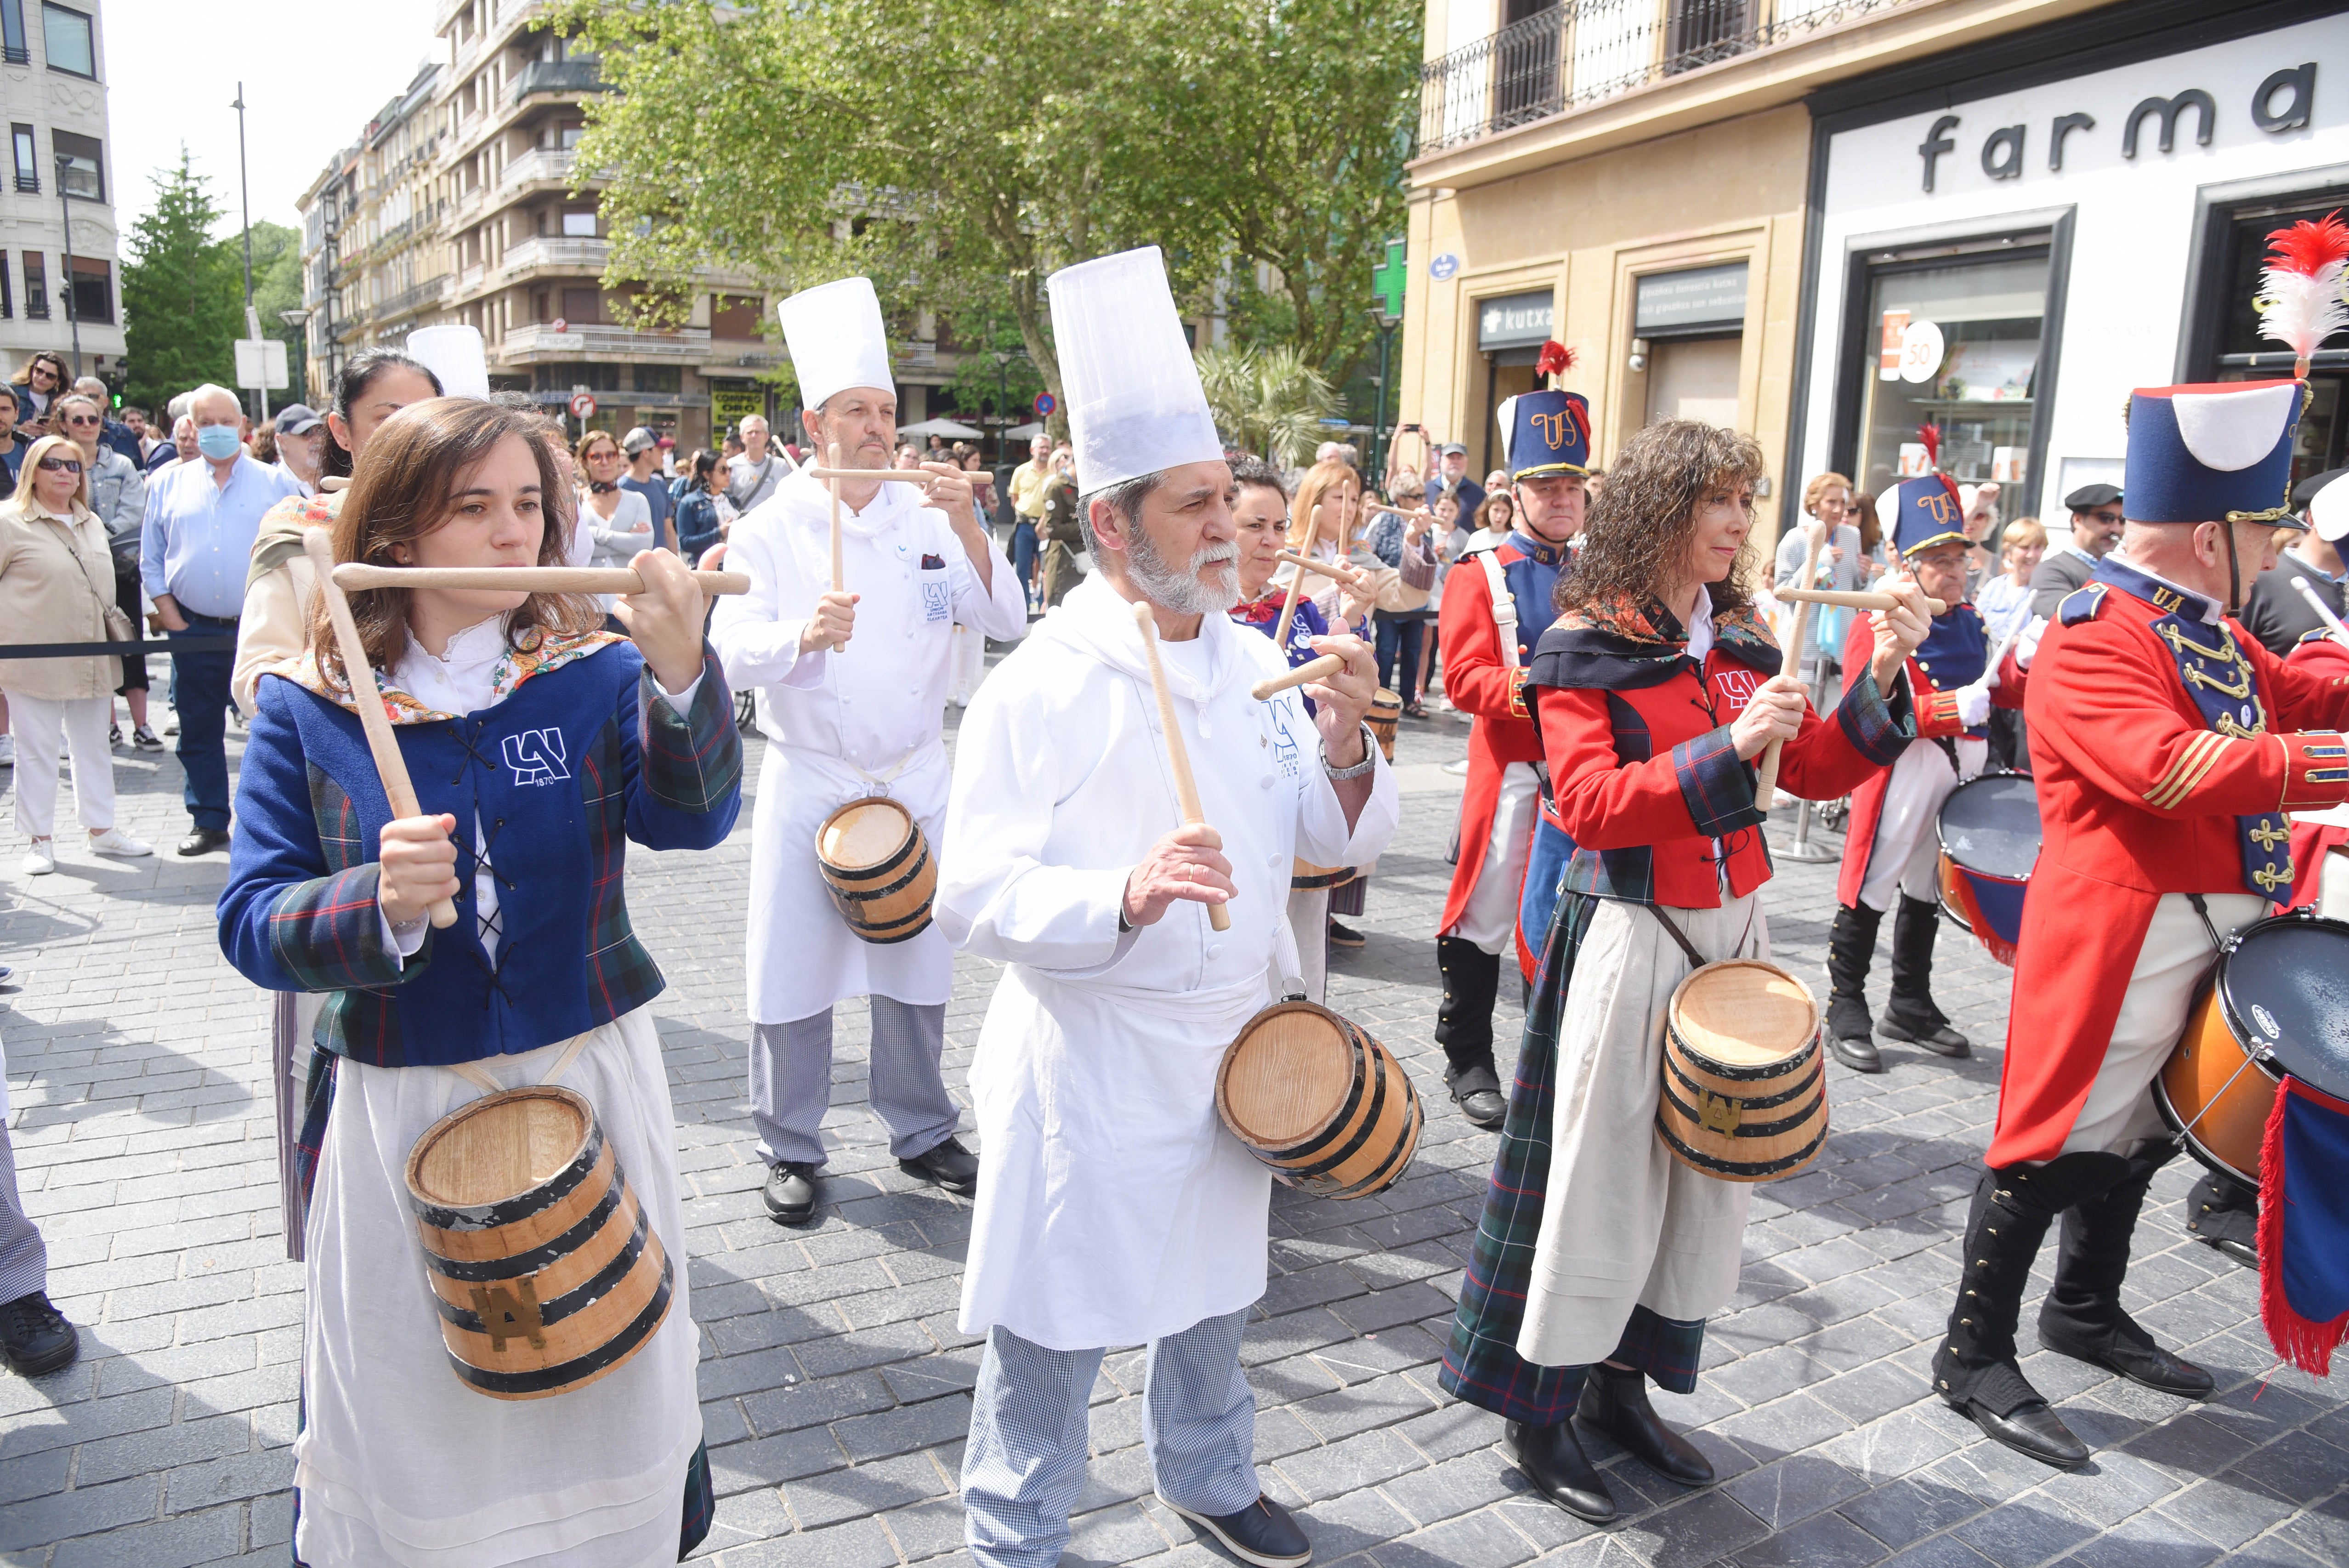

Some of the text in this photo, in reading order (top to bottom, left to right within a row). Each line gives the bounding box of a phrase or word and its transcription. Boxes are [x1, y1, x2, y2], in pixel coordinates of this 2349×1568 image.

[1918, 61, 2318, 192] farma
[1505, 307, 1554, 330] kutxa
[1908, 344, 1930, 365] 50
[1283, 753, 1297, 761] 1870
[534, 776, 554, 787] 1870
[2254, 1008, 2276, 1034] EVANS
